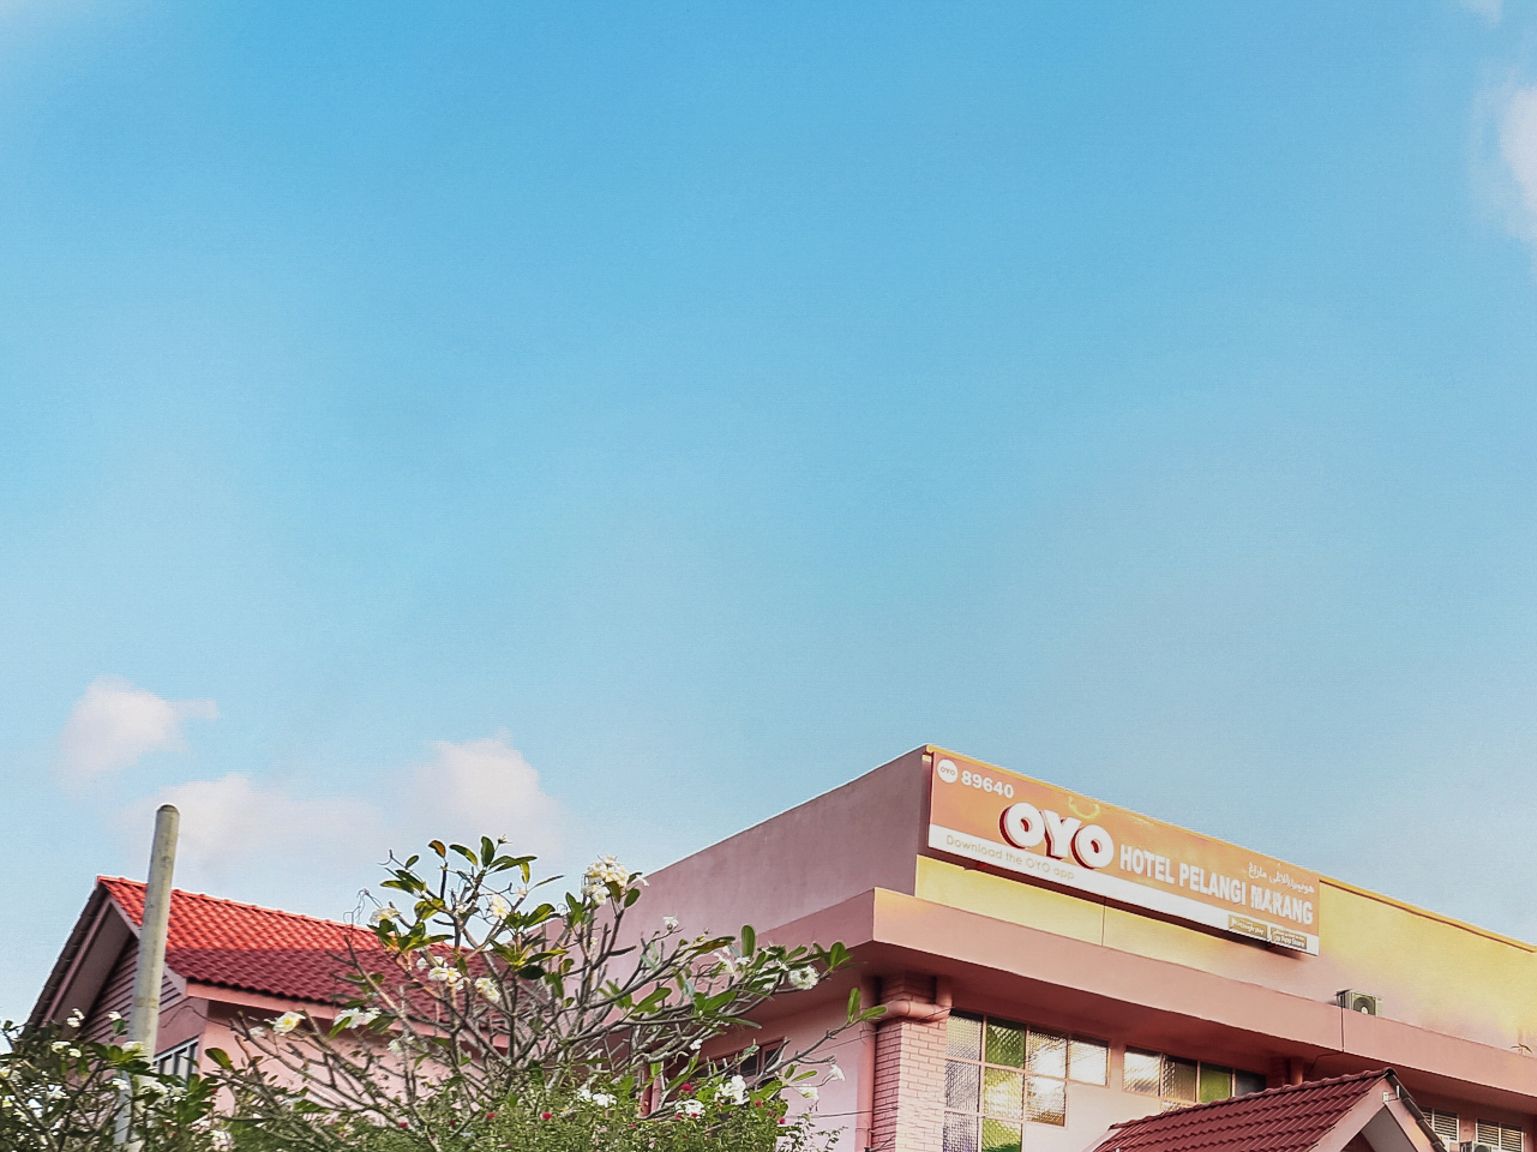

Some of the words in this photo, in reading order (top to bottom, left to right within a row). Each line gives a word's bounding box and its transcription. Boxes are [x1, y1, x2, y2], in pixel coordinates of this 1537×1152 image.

[961, 770, 1014, 798] 89640
[946, 834, 1002, 860] Download
[1005, 852, 1024, 865] the
[1025, 857, 1050, 874] OYO
[1053, 867, 1076, 881] app
[1000, 802, 1115, 869] OYO
[1120, 844, 1175, 884] HOTEL
[1179, 863, 1246, 906] PELANGI
[1251, 885, 1313, 925] MARANG
